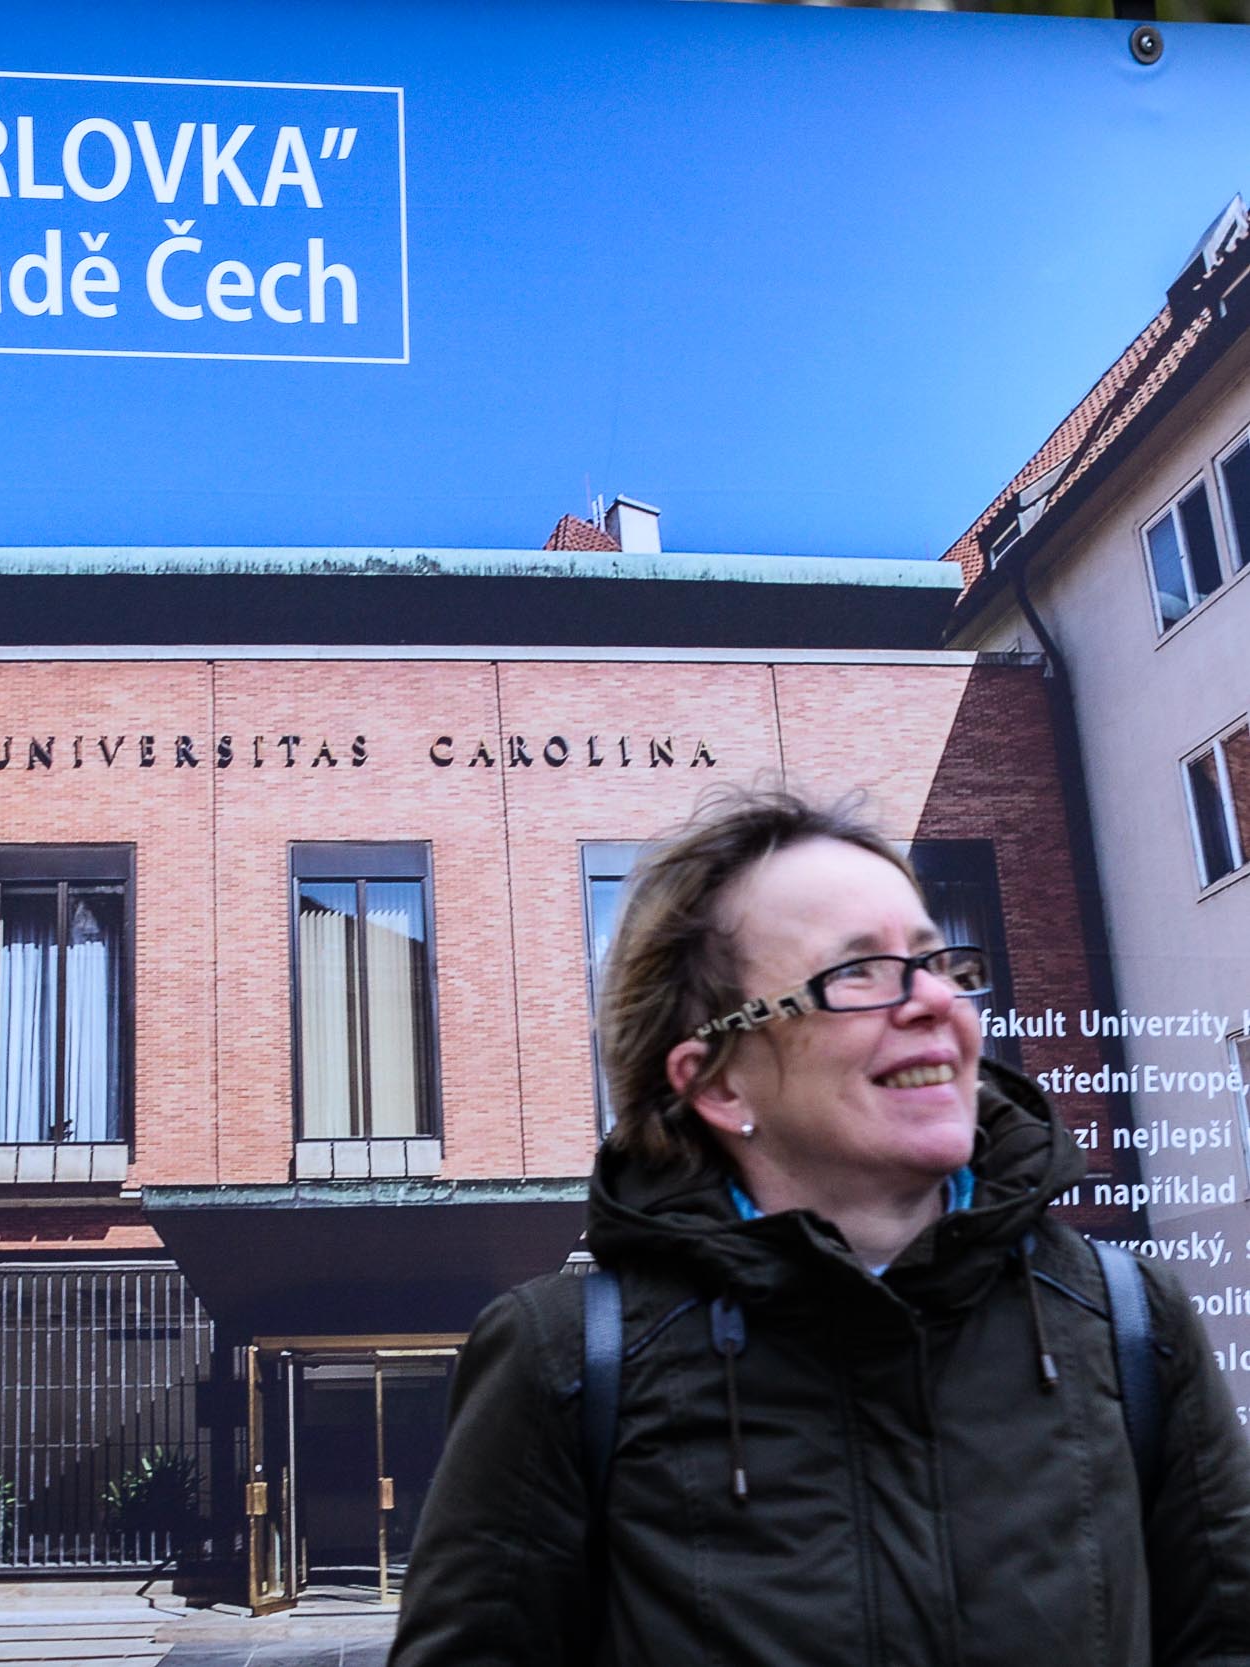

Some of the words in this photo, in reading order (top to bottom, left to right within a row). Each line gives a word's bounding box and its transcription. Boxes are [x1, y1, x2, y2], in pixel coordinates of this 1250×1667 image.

[146, 219, 359, 325] Čech
[429, 735, 718, 769] CAROLINA
[979, 1008, 1067, 1037] fakult
[1079, 1009, 1229, 1044] Univerzity
[1036, 1064, 1140, 1094] střední
[1144, 1064, 1250, 1099] Evropě,
[1073, 1120, 1099, 1149] zi
[1113, 1119, 1232, 1156] nejlepší
[1094, 1175, 1237, 1212] například
